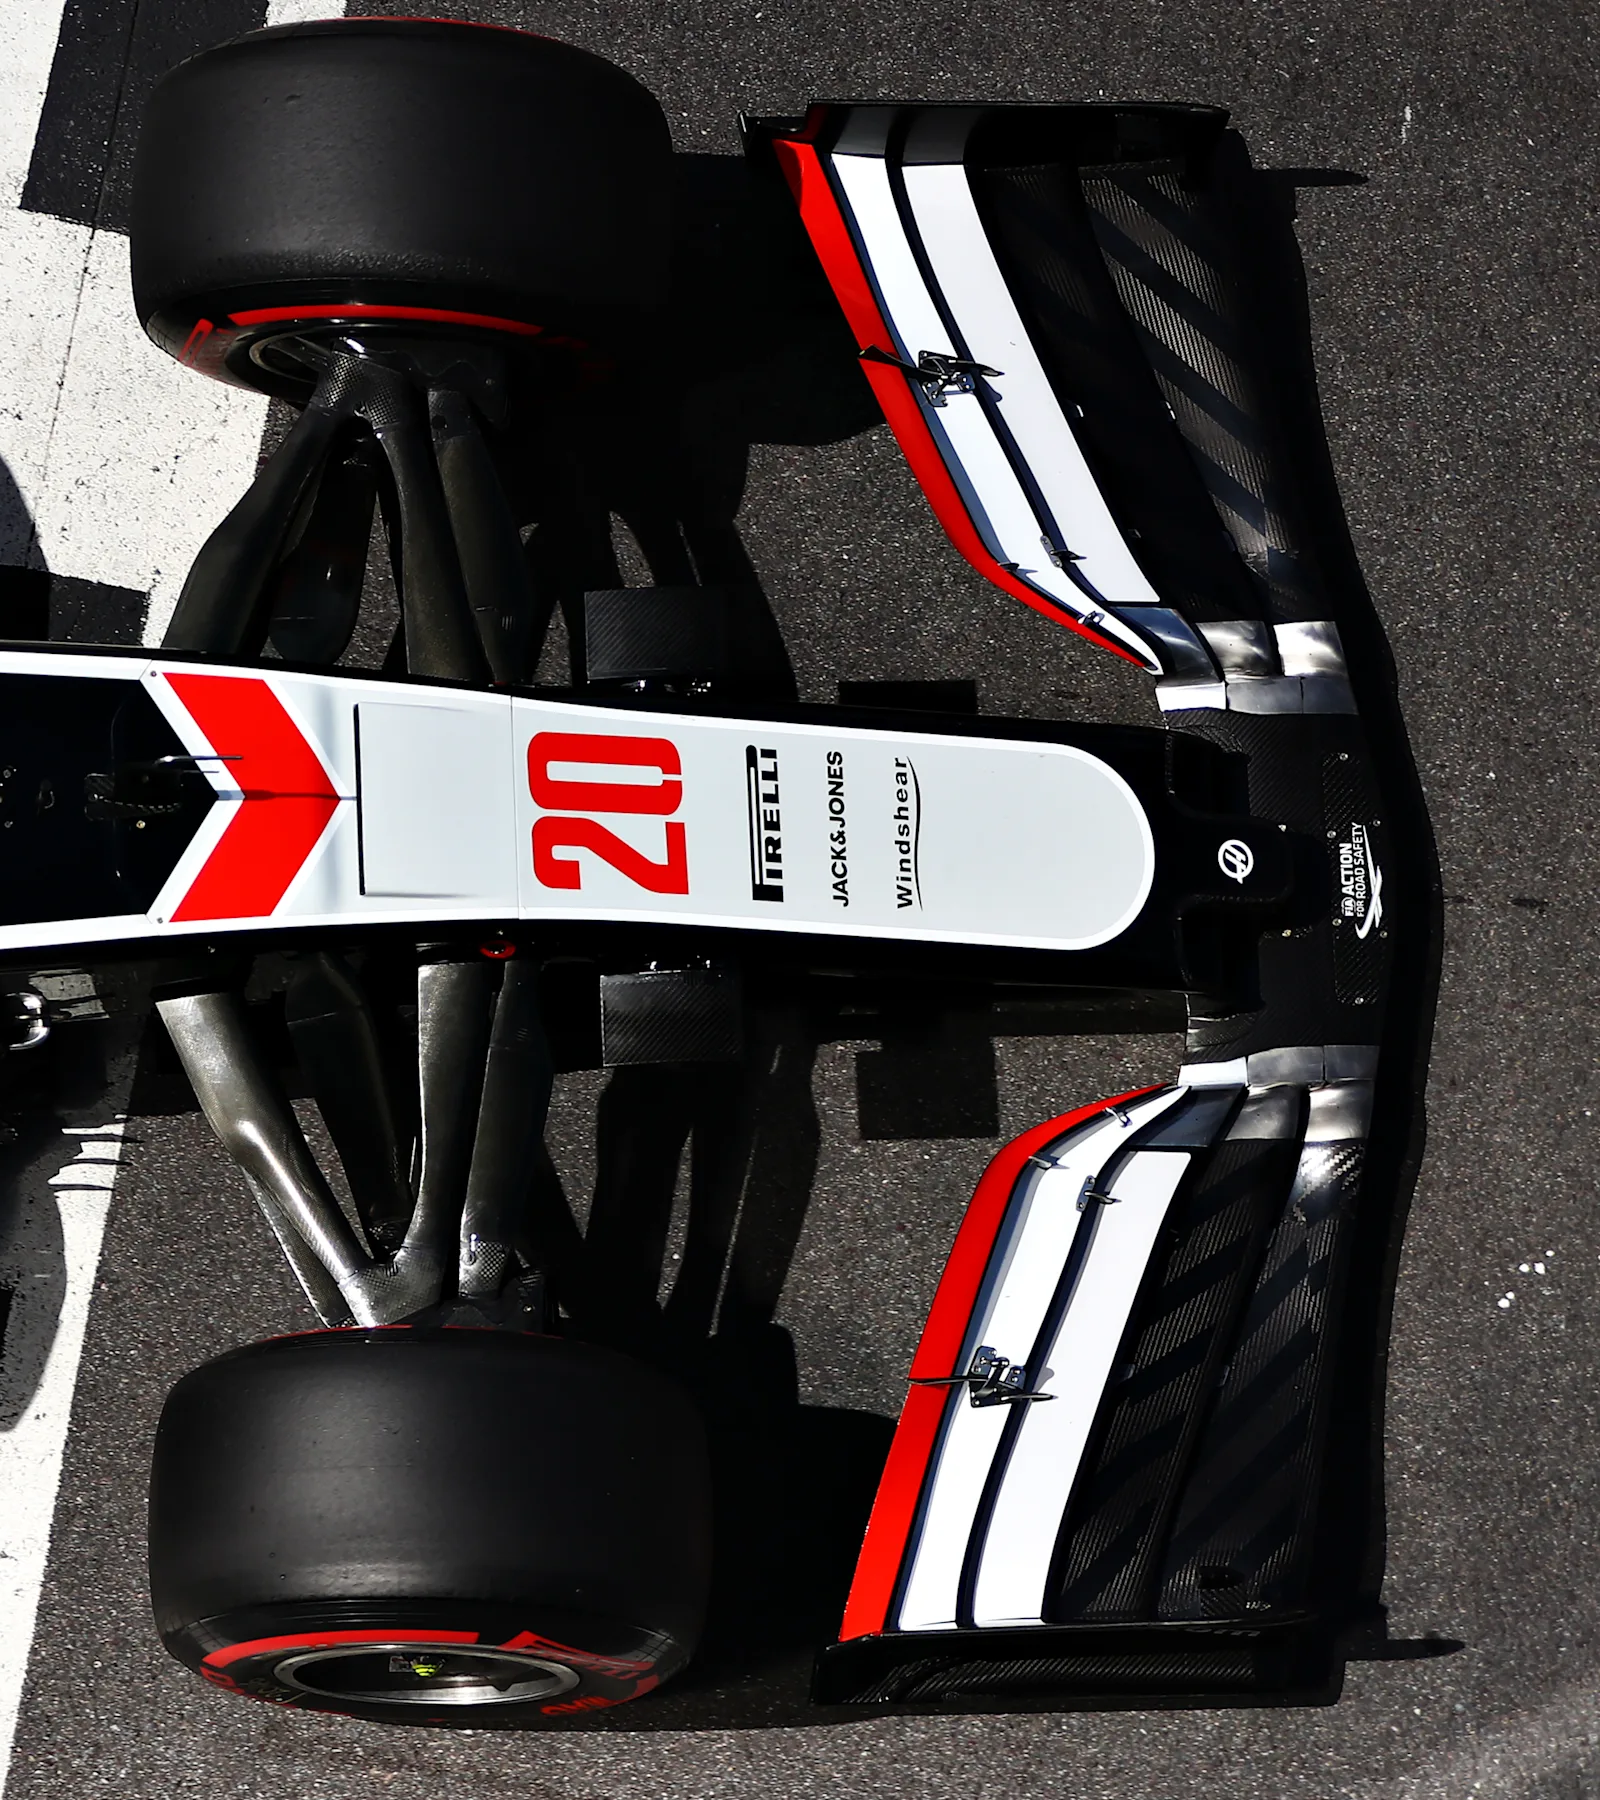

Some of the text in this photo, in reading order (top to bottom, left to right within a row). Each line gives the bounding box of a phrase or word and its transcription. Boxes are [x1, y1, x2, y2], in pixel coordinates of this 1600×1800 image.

[527, 731, 689, 895] 20
[746, 744, 784, 902] PIRELLI
[826, 750, 850, 908] JACK&JONES
[893, 757, 913, 909] Windshear
[1339, 842, 1355, 917] FIA ACTION
[1351, 822, 1366, 918] FOR ROAD SAFETY
